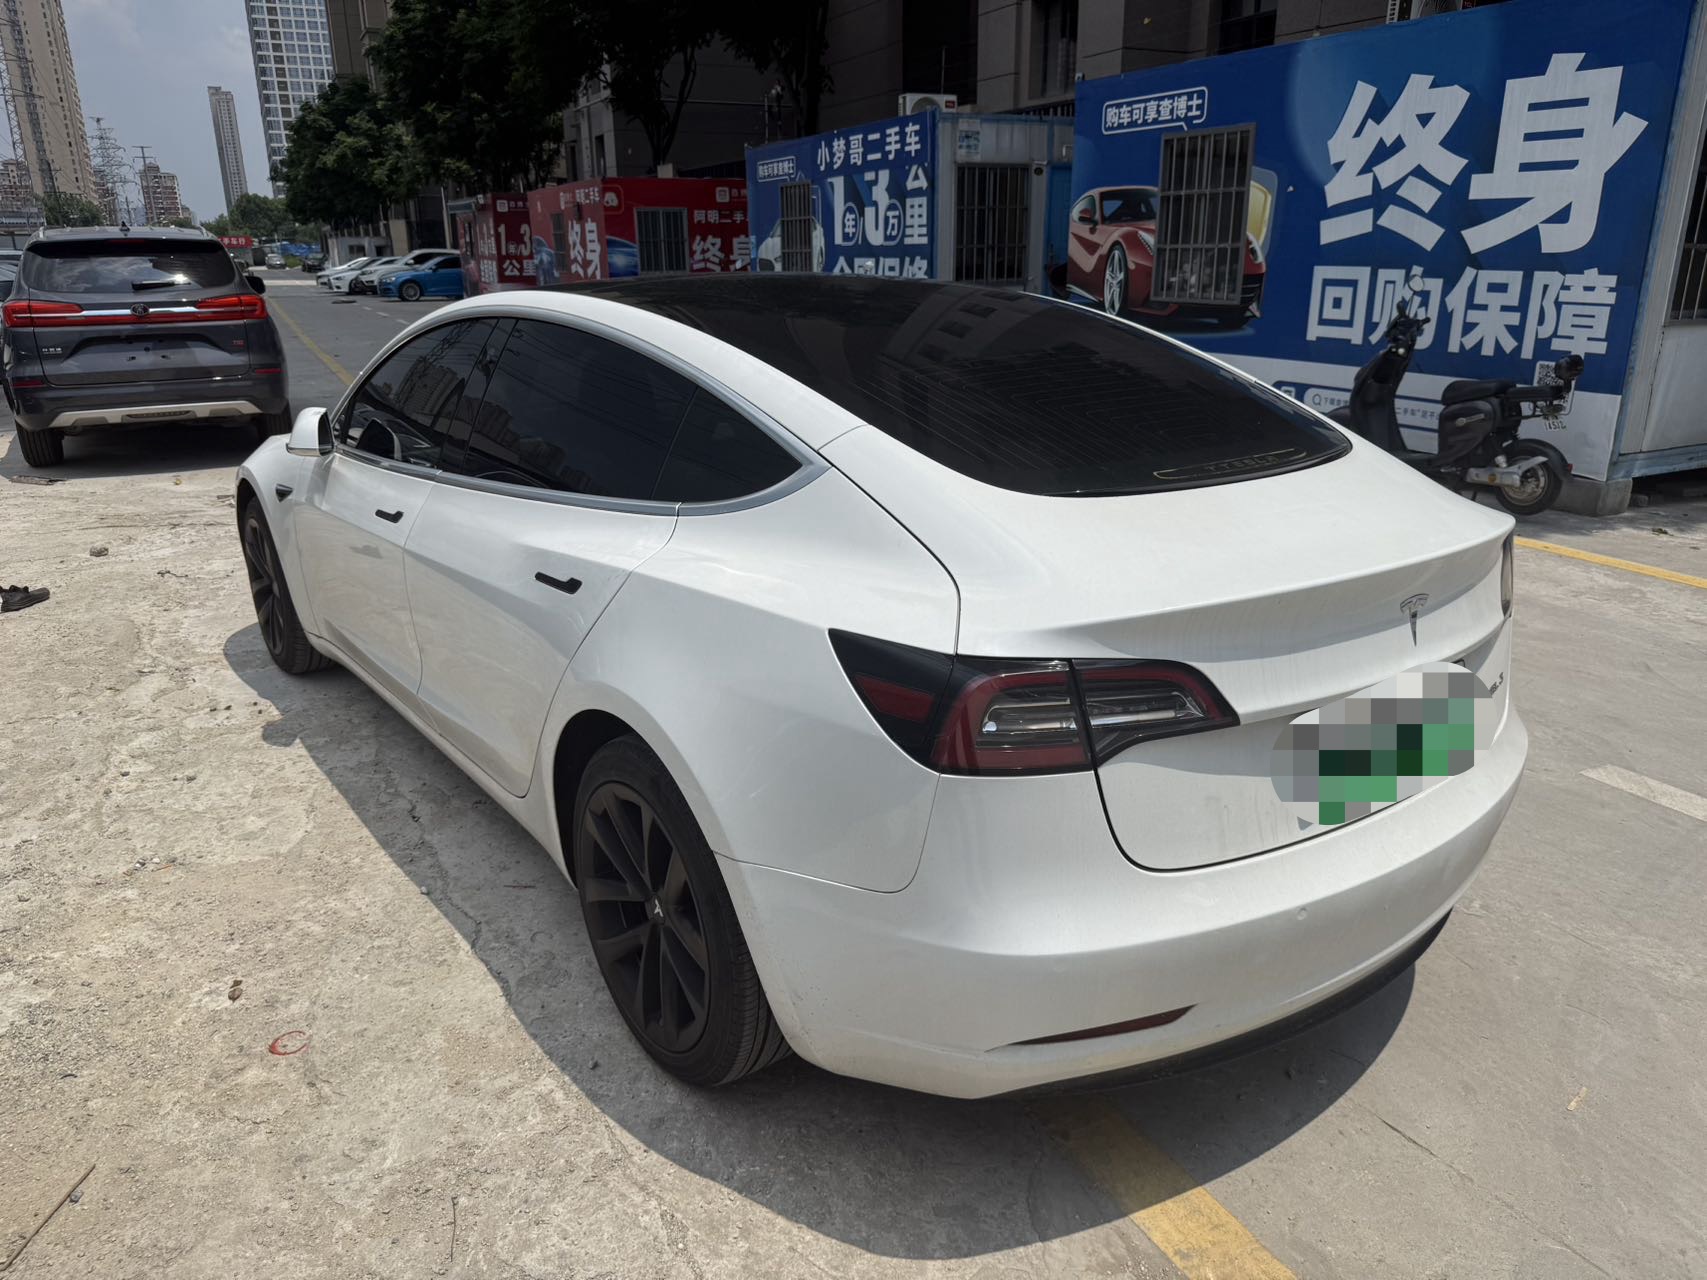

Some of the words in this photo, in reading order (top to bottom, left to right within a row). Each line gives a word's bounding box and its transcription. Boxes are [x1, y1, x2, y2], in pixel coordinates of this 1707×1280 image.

[1105, 93, 1203, 128] 购车可享查博士
[817, 122, 922, 172] 小梦哥二手车
[1319, 52, 1649, 254] 终身
[694, 210, 748, 224] 阿明二手
[218, 237, 246, 246] 手车行
[1306, 265, 1618, 361] 回购保障
